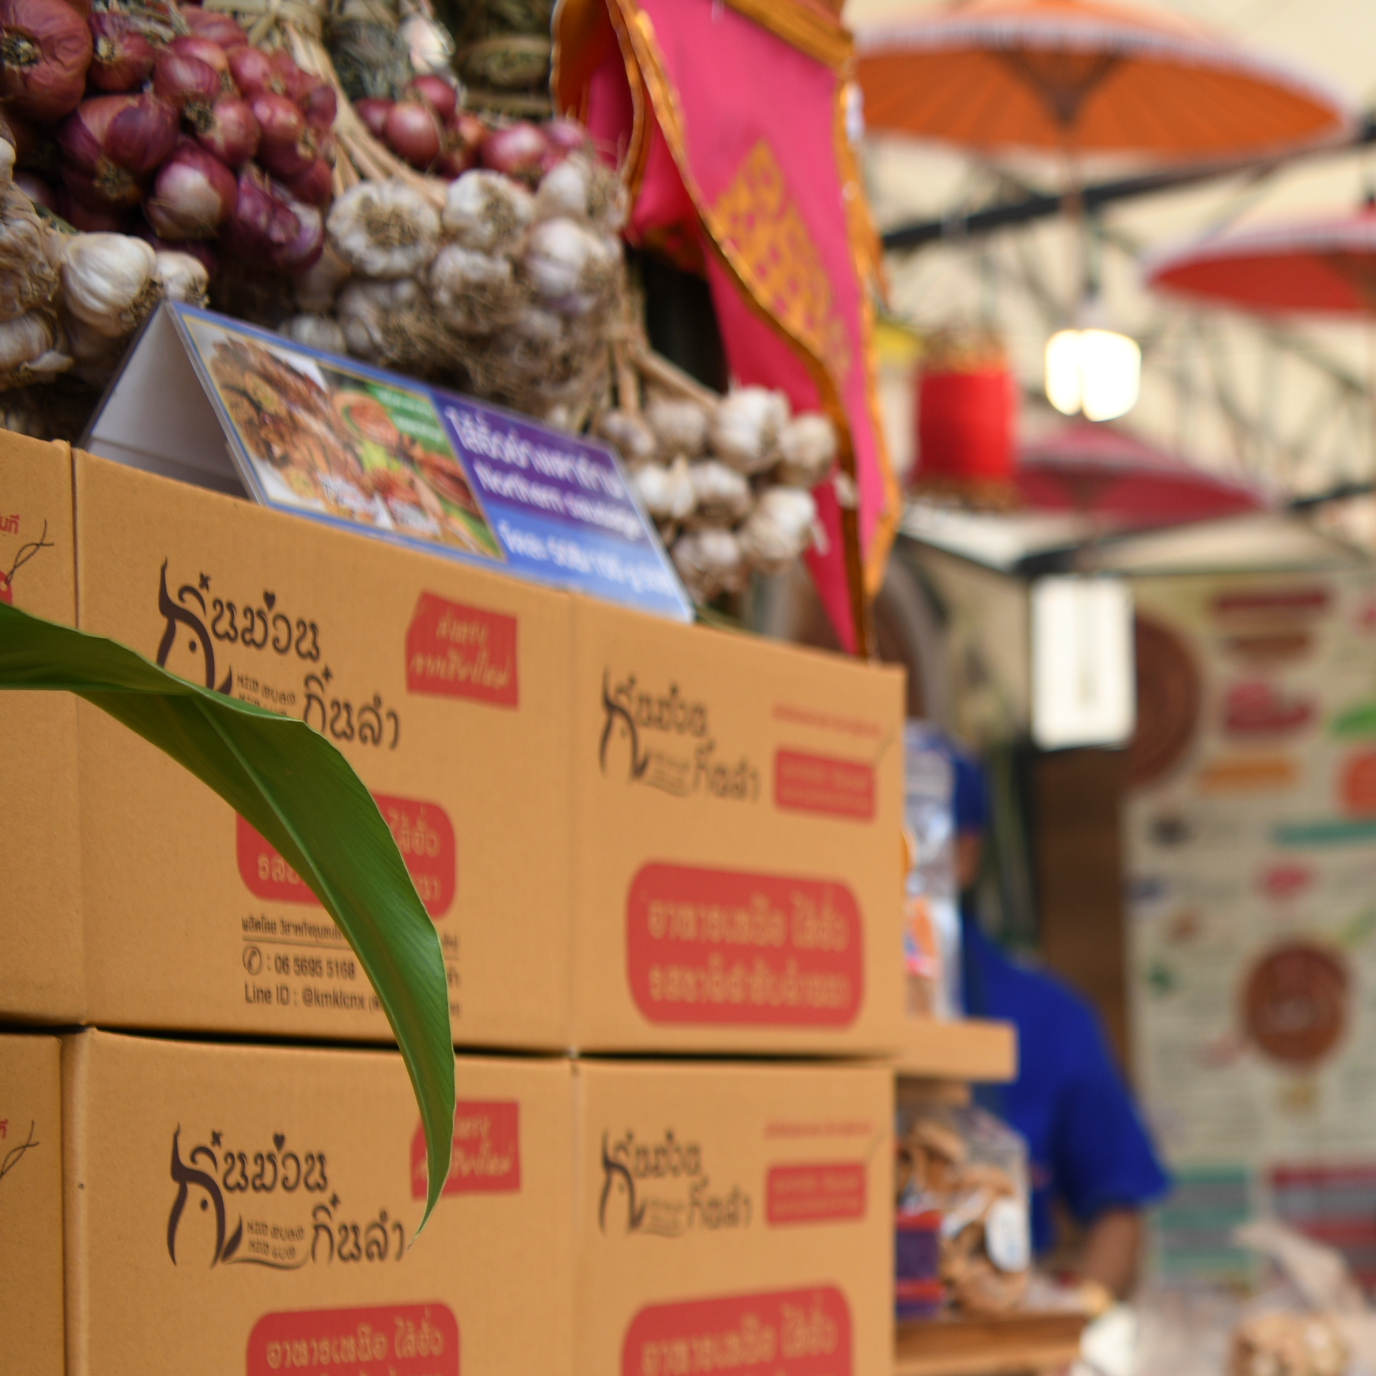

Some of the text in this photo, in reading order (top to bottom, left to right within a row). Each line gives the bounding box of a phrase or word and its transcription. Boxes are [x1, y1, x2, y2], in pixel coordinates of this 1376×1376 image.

[473, 458, 567, 516] Northern
[274, 954, 290, 976] 06
[293, 956, 324, 979] 5695
[326, 959, 356, 982] 5168
[244, 982, 272, 1005] Line
[275, 984, 291, 1007] ID
